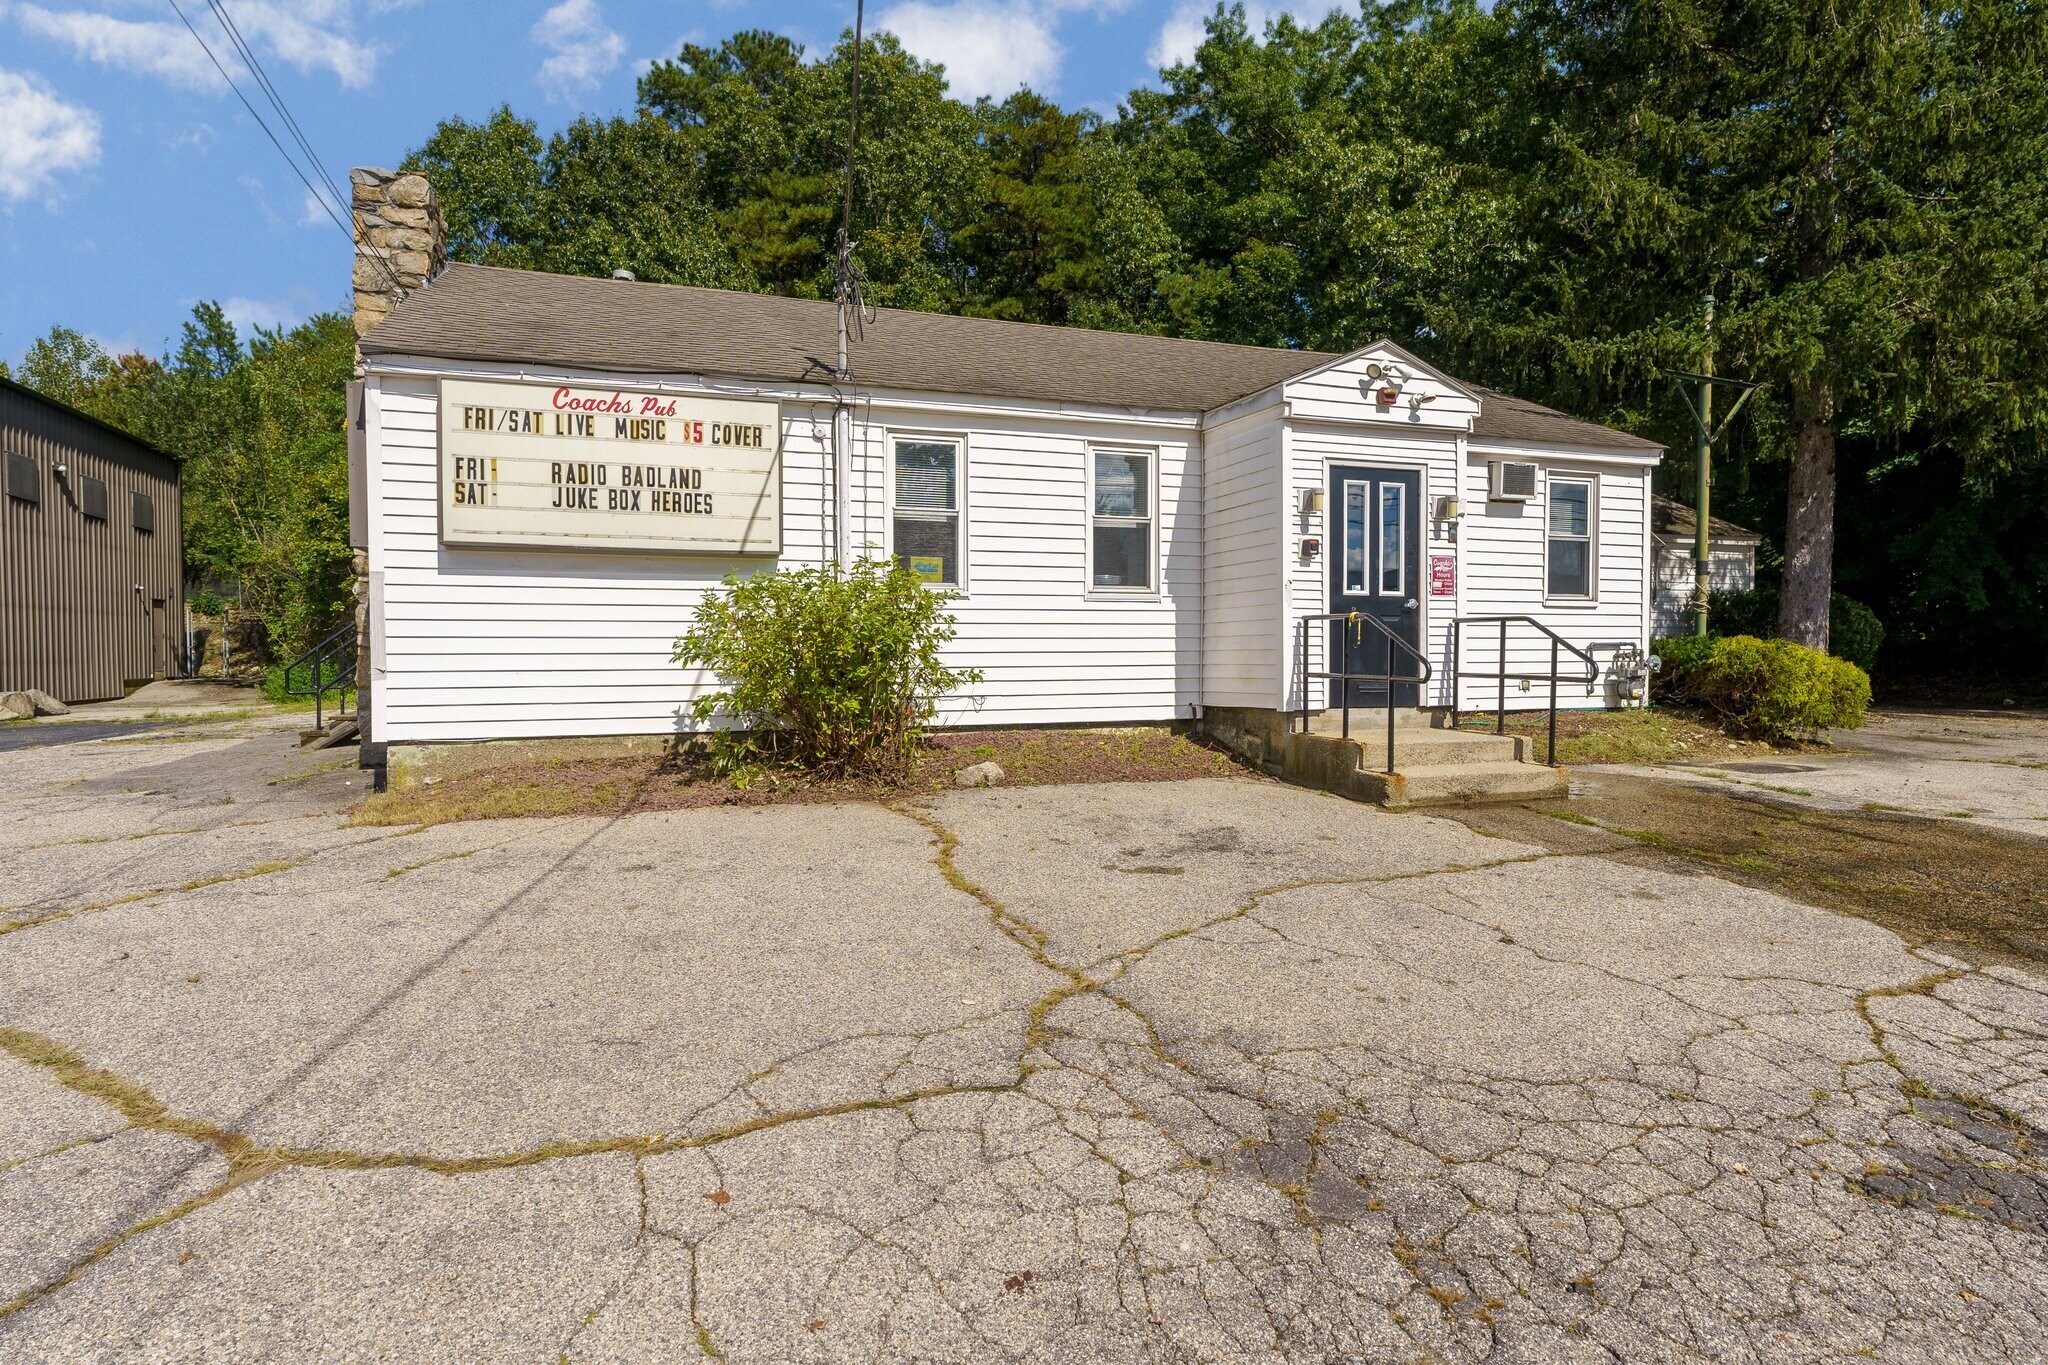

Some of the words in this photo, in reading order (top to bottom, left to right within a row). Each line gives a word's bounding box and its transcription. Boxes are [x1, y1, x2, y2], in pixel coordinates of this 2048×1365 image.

[552, 387, 633, 414] Coachs
[640, 397, 677, 417] Pub
[464, 407, 543, 434] FRI/SAT
[556, 413, 594, 436] LIVE
[615, 418, 666, 440] MUSIC
[683, 422, 703, 443] $5
[711, 424, 762, 447] COVER
[551, 462, 607, 486] RADIO
[622, 465, 701, 490] BADLAND
[552, 487, 598, 509] JUKE
[608, 489, 641, 511] BOX
[651, 491, 713, 514] HEROES
